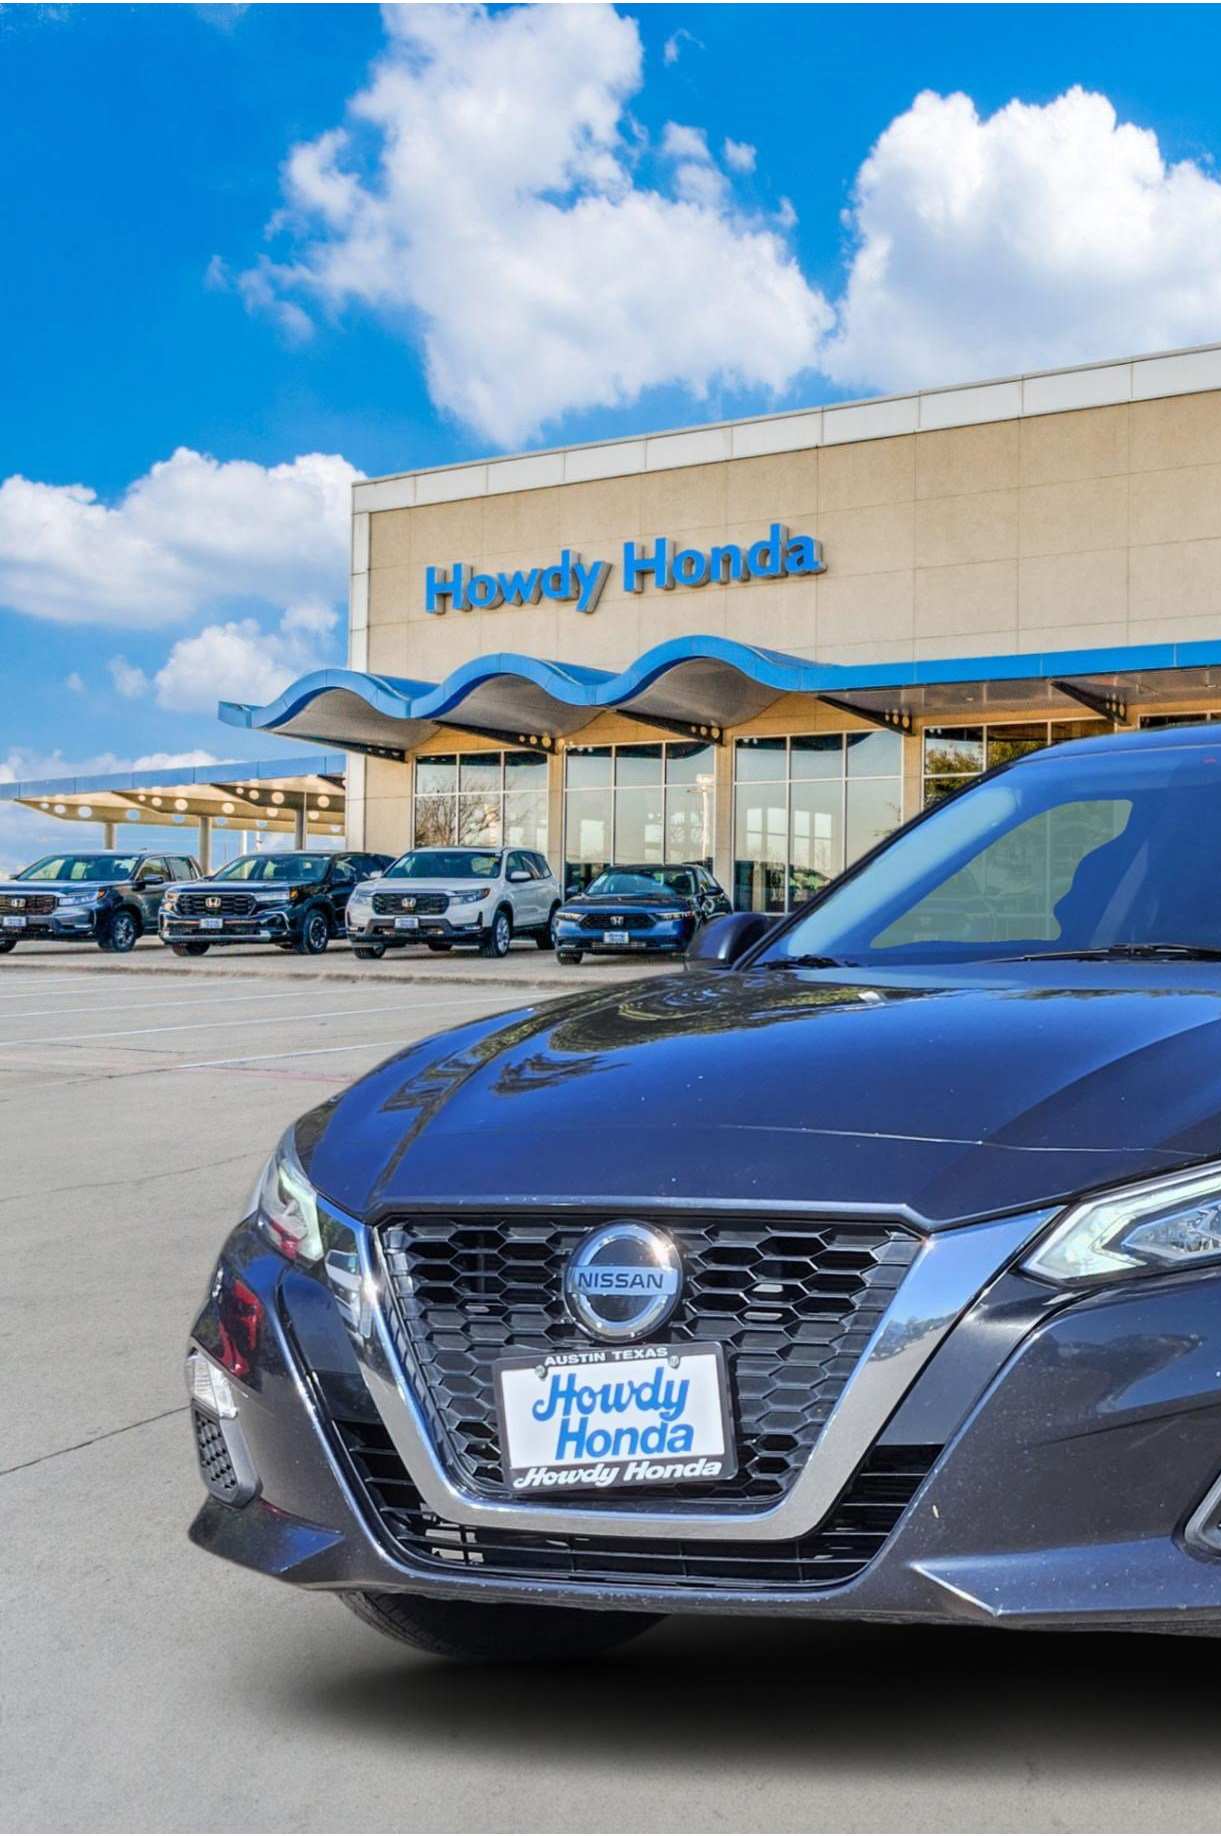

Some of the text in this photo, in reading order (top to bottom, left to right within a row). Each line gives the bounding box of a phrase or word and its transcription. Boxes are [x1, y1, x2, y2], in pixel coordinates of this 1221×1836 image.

[425, 523, 827, 614] Howdy Honda
[578, 1273, 664, 1289] NISSAN
[545, 1347, 668, 1366] AUSTIN TEXAS
[532, 1366, 690, 1421] Howdy
[555, 1417, 694, 1460] Honda
[513, 1458, 723, 1488] Howdy Honda
